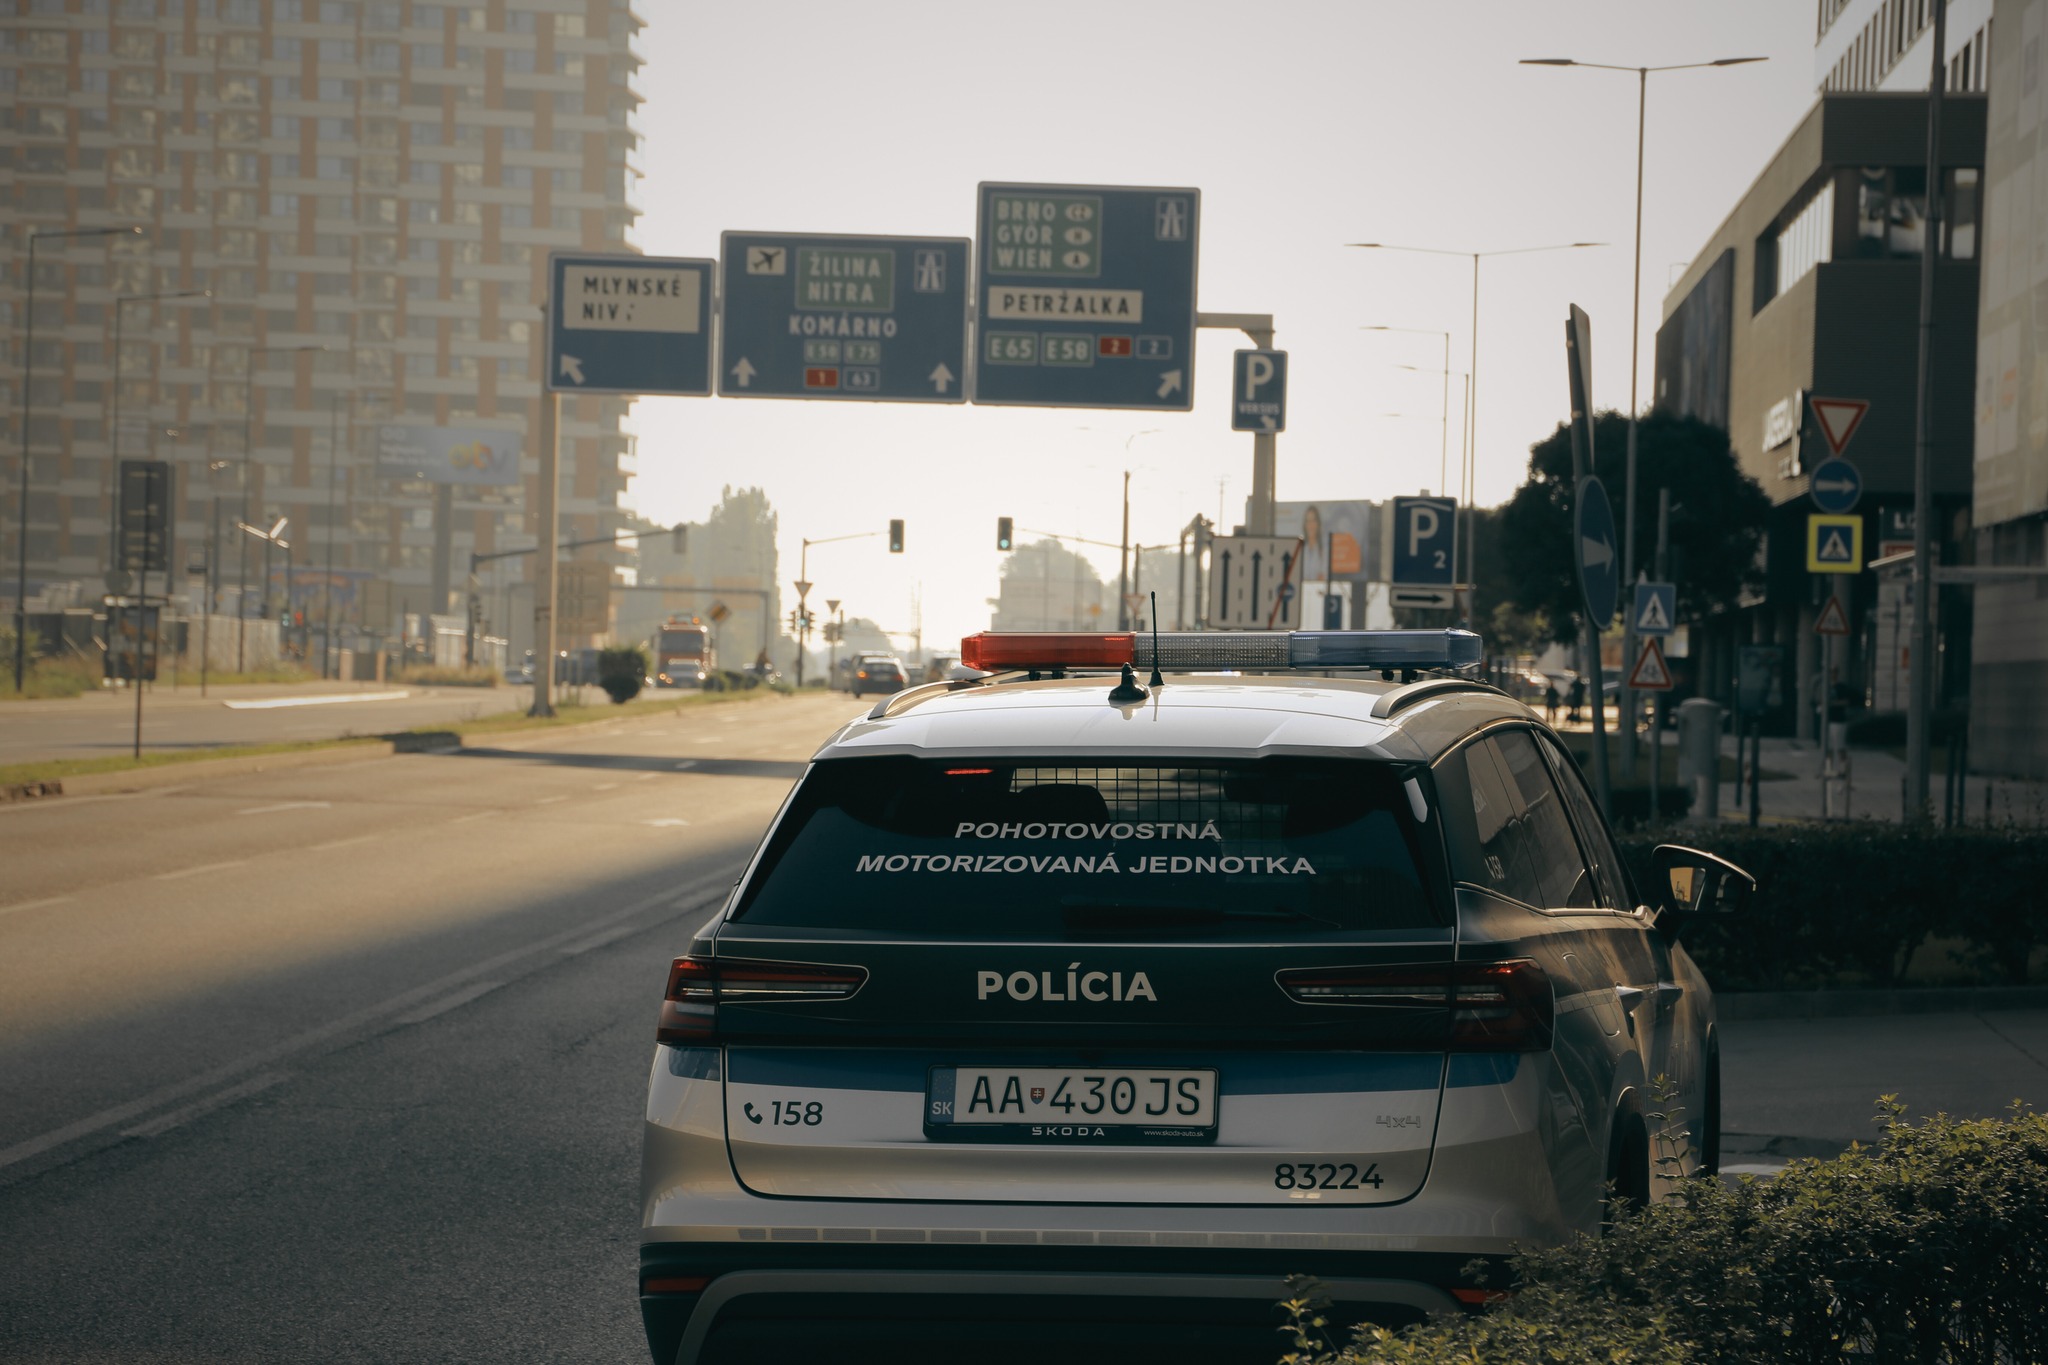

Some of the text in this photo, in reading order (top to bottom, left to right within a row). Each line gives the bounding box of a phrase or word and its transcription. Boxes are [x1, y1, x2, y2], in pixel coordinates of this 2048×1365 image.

[997, 200, 1056, 222] BRNO
[809, 251, 881, 278] ŽILINA
[997, 247, 1052, 269] WIEN
[583, 273, 681, 297] MLYNSKÉ
[808, 281, 874, 304] NITRA
[1003, 290, 1130, 315] PETRŽALKA
[789, 310, 897, 338] KOMÁRNO
[1111, 338, 1120, 354] 2
[1246, 354, 1274, 401] P
[1409, 506, 1439, 557] P
[1433, 550, 1446, 569] 2
[954, 818, 1222, 840] POHOTOVOSTNÁ
[855, 852, 1317, 875] MOTORIZOVANÁ JEDNOTKA
[977, 961, 1158, 1002] POLÍCIA
[771, 1100, 823, 1126] 158
[932, 1101, 952, 1115] SK
[1143, 1129, 1204, 1138] www.skoda-auto.sk
[1375, 1115, 1421, 1129] 4x4
[1274, 1163, 1384, 1190] 83224
